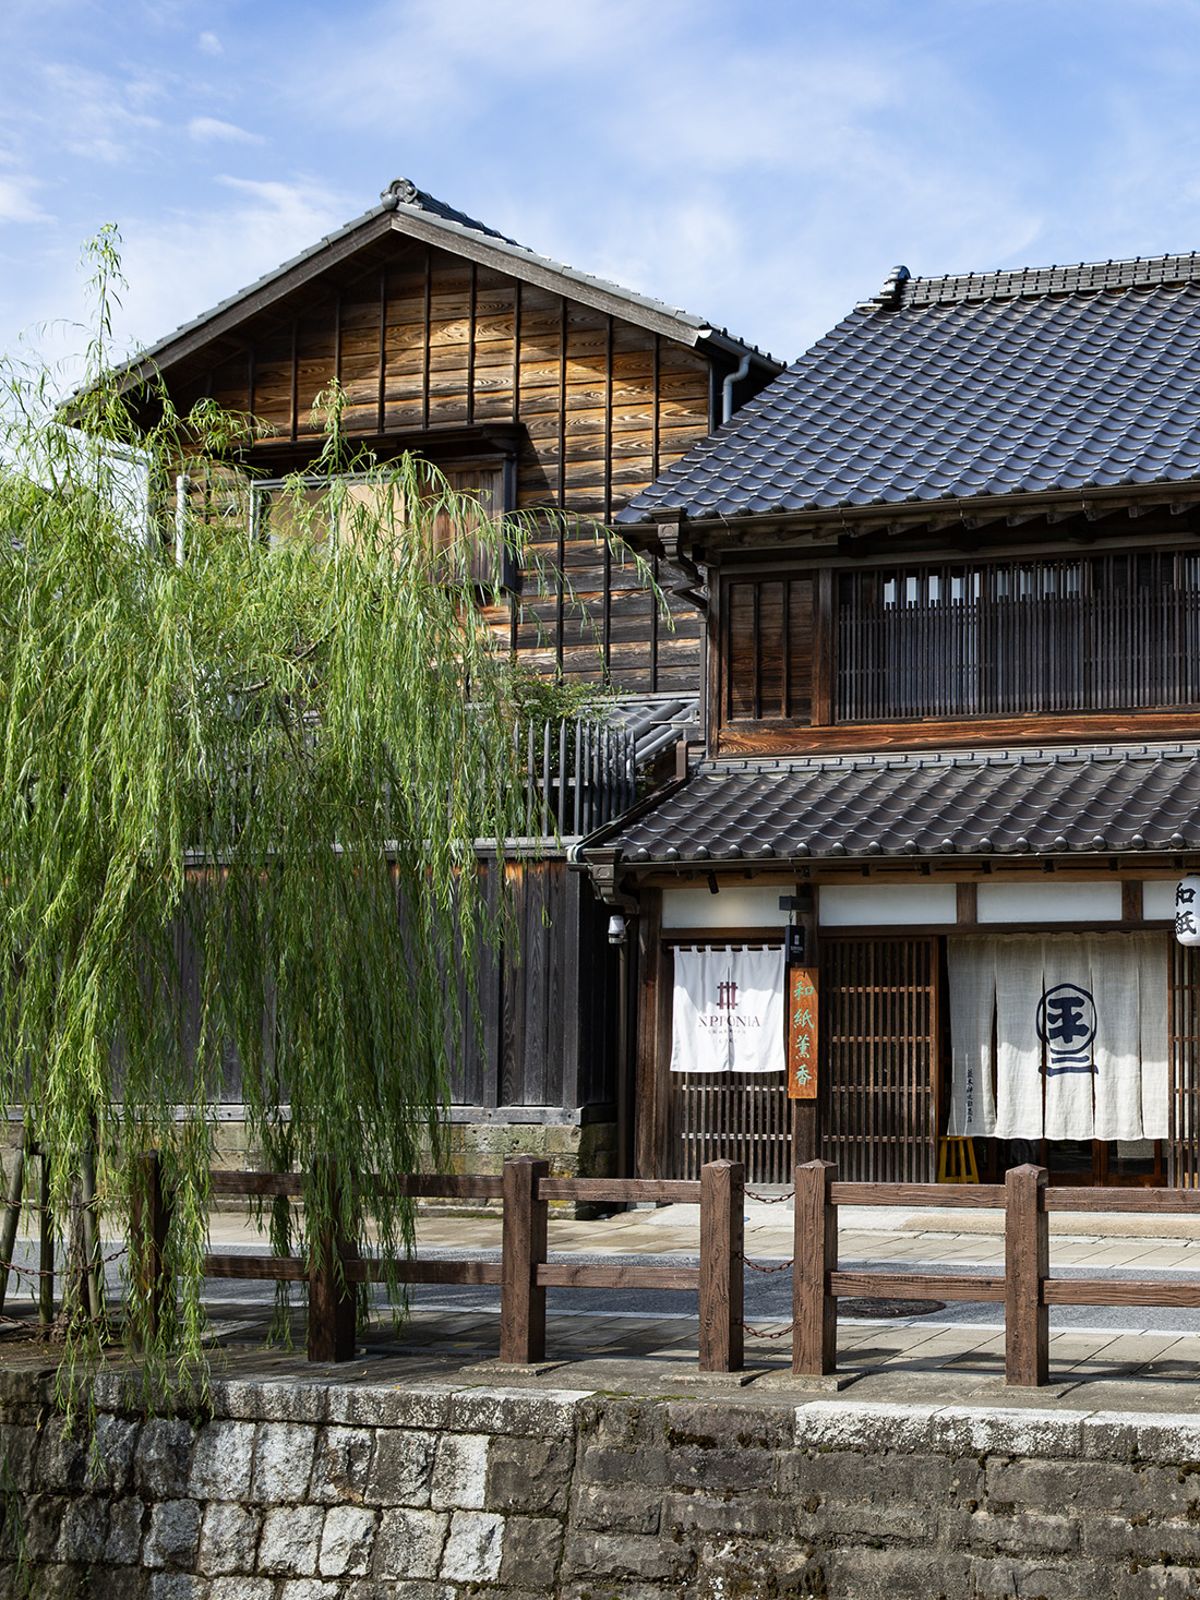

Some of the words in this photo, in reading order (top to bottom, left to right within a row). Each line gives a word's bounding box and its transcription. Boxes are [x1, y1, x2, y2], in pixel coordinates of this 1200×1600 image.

[1175, 882, 1197, 935] 和紙
[793, 981, 815, 1086] 和紙薫香
